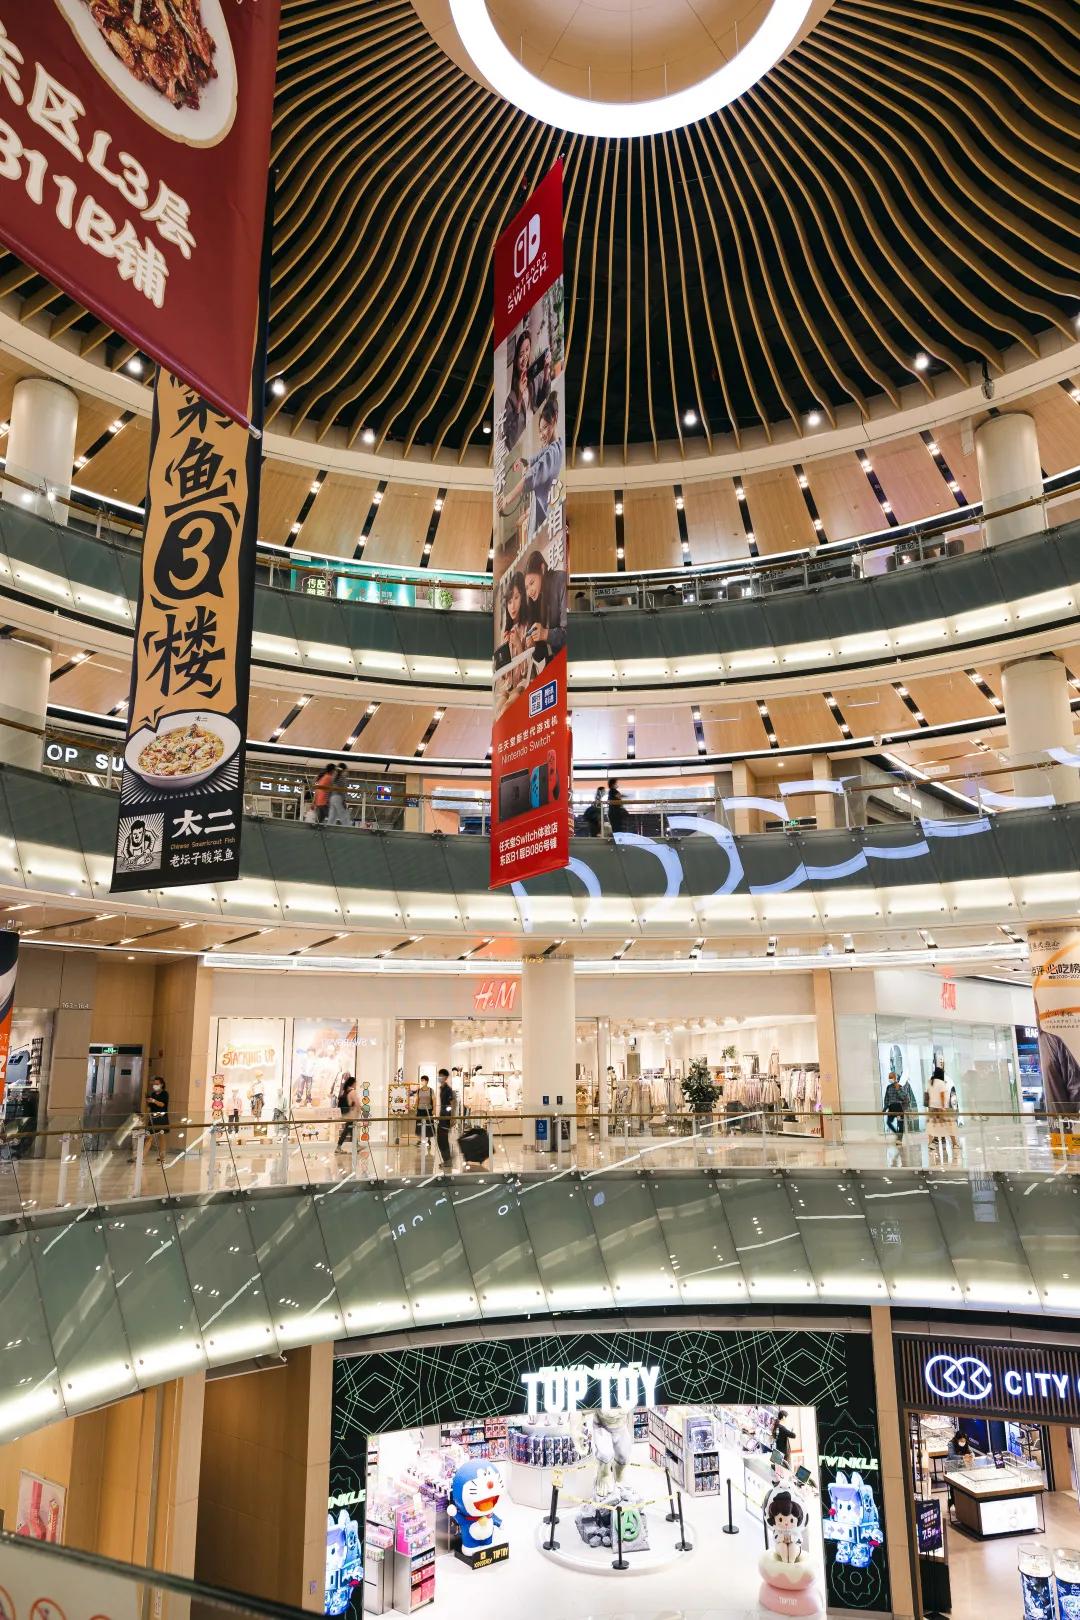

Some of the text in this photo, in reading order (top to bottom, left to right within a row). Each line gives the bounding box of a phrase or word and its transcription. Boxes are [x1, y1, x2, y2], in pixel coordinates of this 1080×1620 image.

[507, 252, 547, 301] NINTENDO
[507, 261, 548, 315] SWITCH
[501, 746, 528, 766] Nintendo
[172, 809, 236, 838] 太二
[170, 848, 234, 868] 老坛子酸菜鱼
[473, 981, 518, 1009] H&M
[521, 1364, 660, 1416] TOP TOY
[1004, 1370, 1068, 1399] CITY
[818, 1454, 879, 1471] TWINKLE
